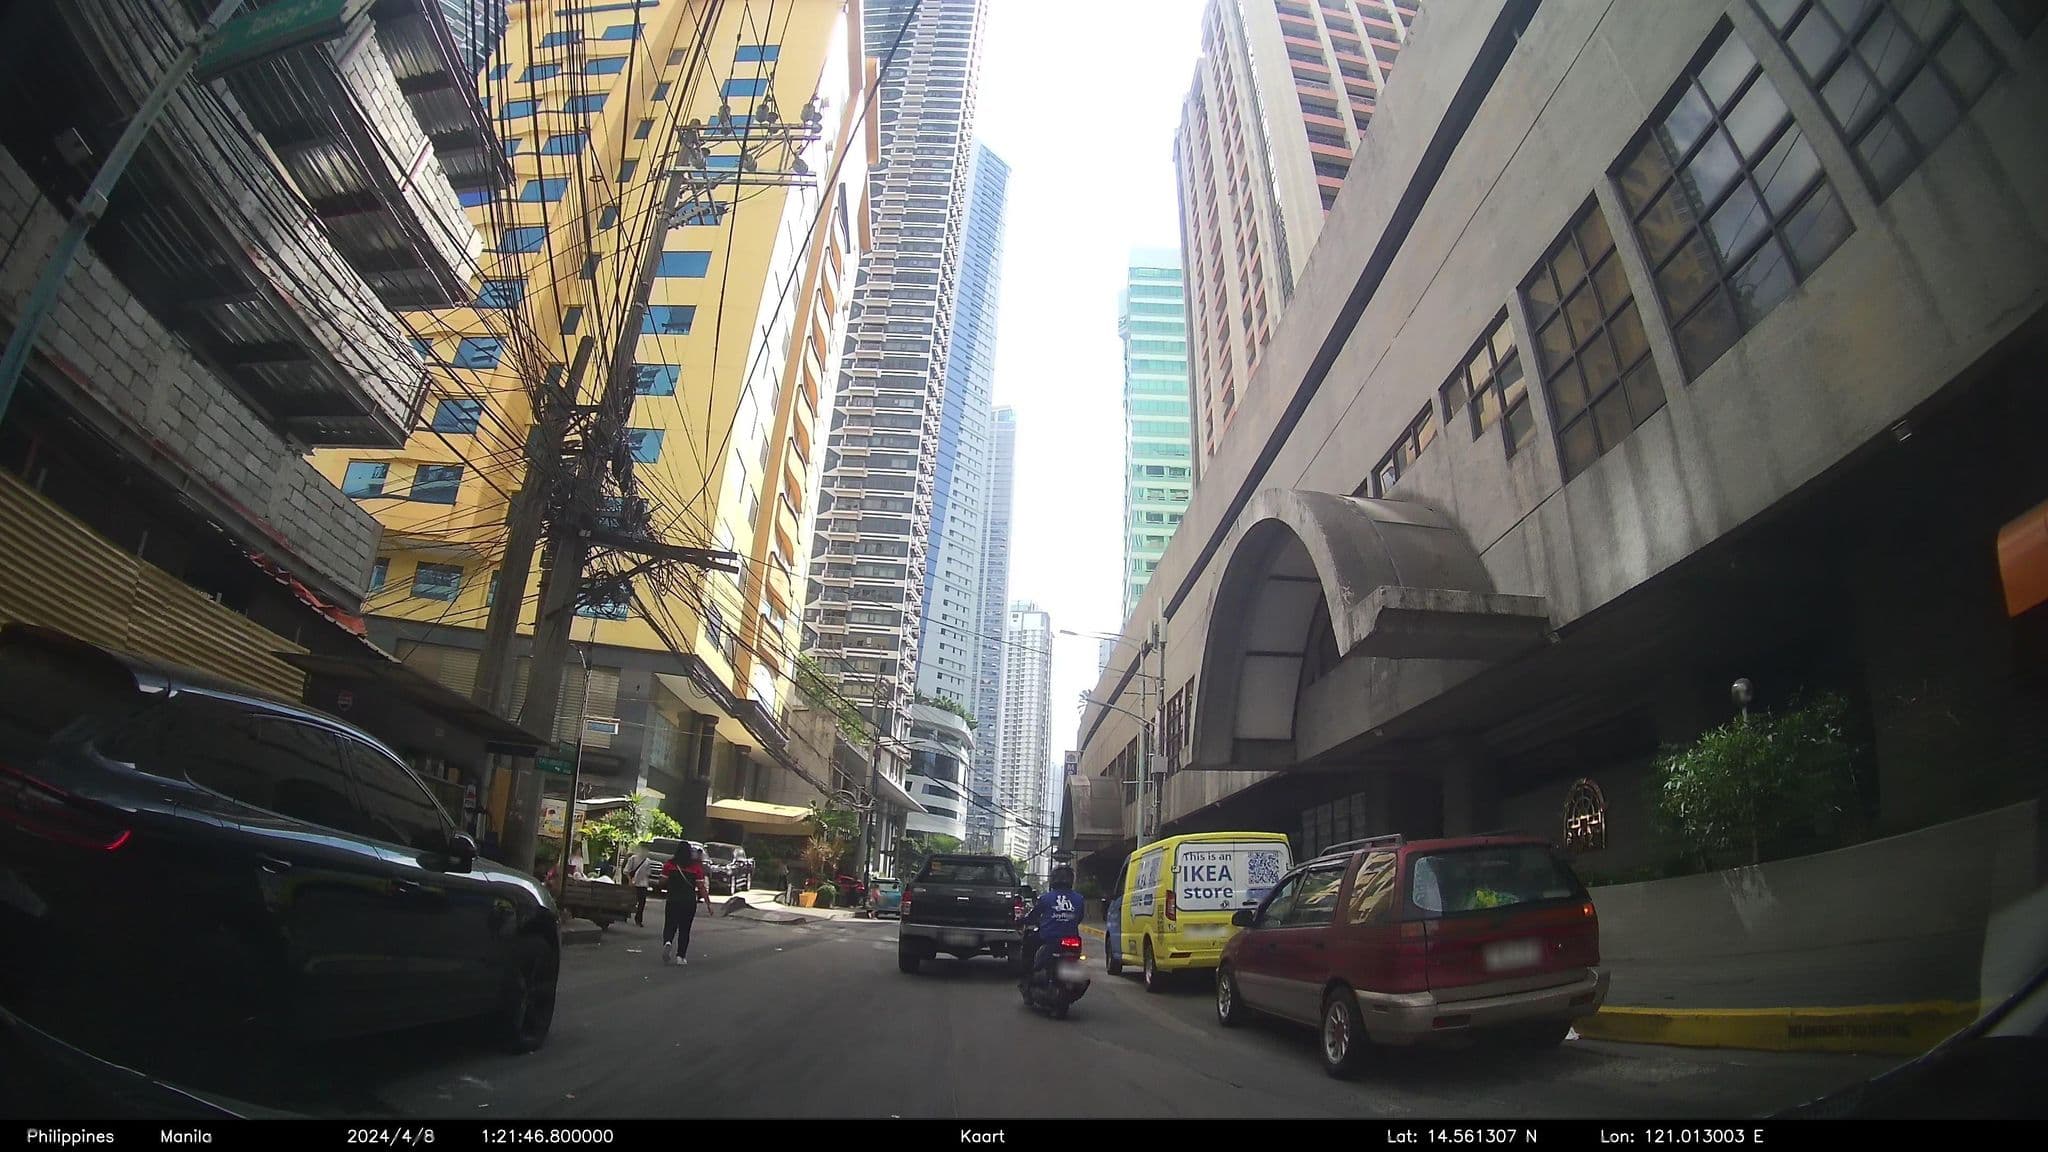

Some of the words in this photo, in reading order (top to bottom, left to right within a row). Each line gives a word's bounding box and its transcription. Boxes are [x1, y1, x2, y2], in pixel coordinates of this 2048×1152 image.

[1184, 852, 1205, 861] This
[1208, 852, 1215, 861] is
[1219, 853, 1231, 861] an
[1184, 865, 1232, 882] IKEA
[1184, 887, 1233, 899] store
